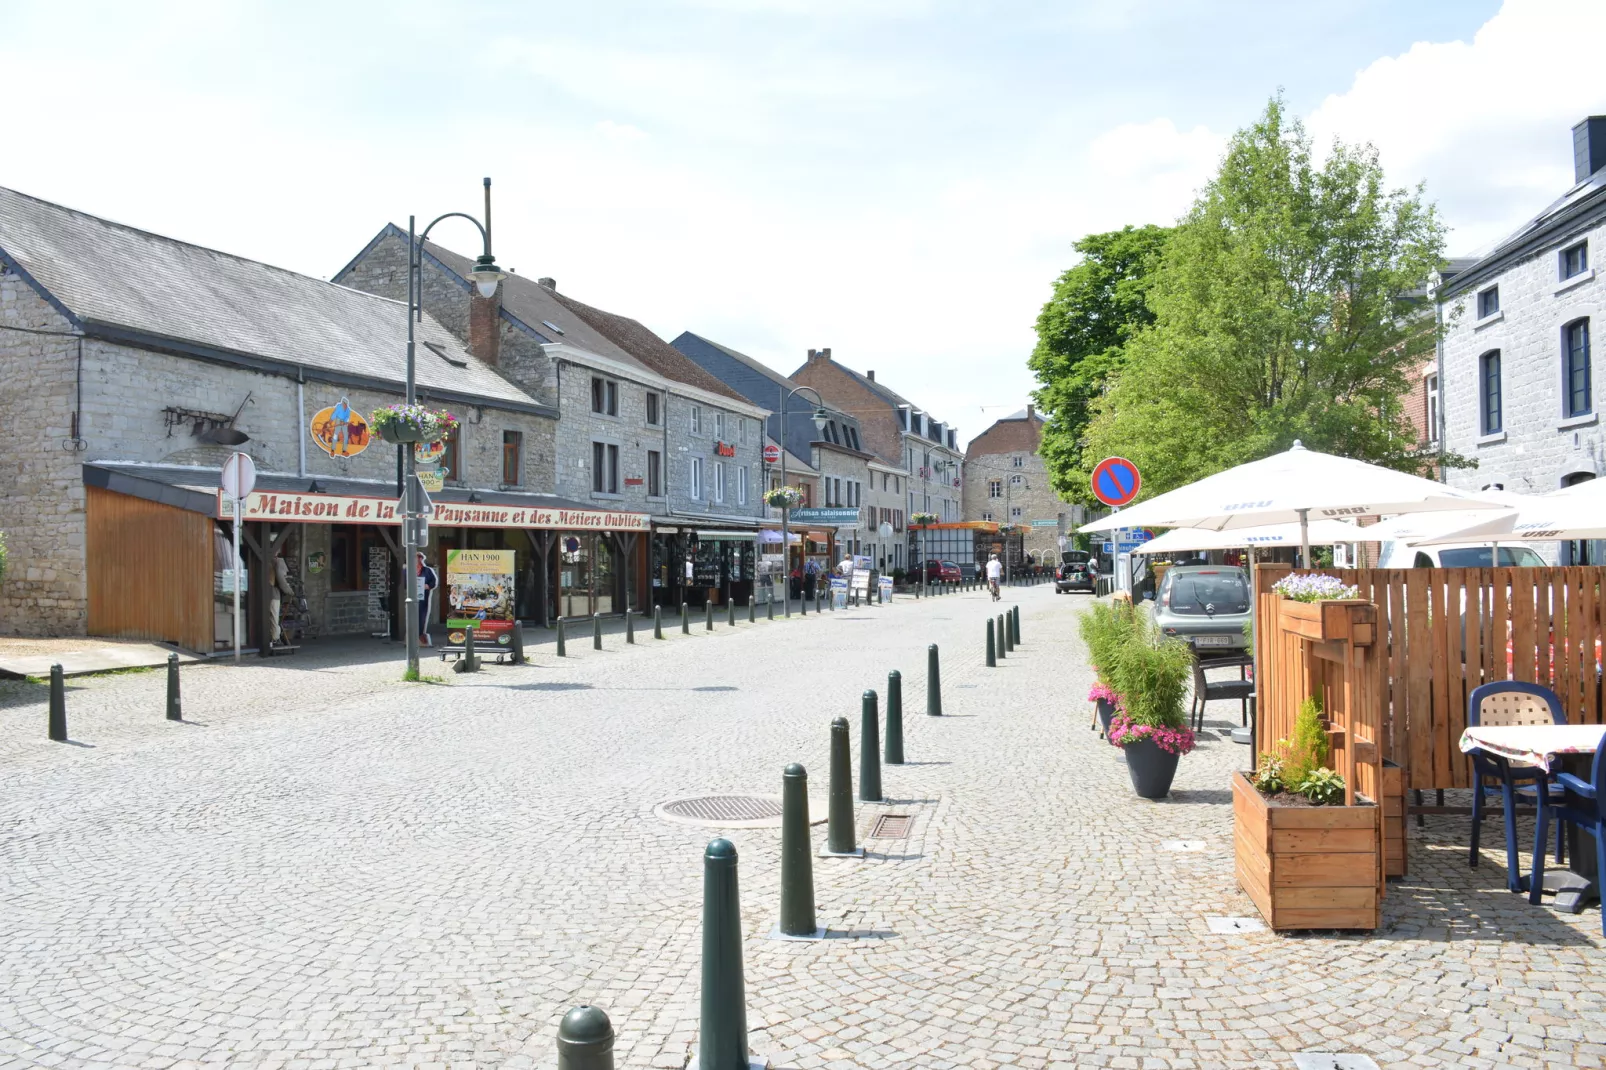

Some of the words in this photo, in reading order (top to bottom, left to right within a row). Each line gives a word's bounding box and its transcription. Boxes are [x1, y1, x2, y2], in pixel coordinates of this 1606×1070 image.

[250, 495, 339, 517] Maison
[346, 499, 369, 518] de
[376, 501, 395, 519] la
[791, 508, 819, 518] Artisan
[821, 509, 859, 517] salaisonnier
[433, 504, 508, 524] Paysanne
[512, 509, 525, 523] et
[530, 509, 551, 525] des
[555, 510, 601, 527] Métiers
[604, 513, 642, 528] Oubliés
[461, 553, 479, 561] HAN
[482, 553, 500, 561] 1900
